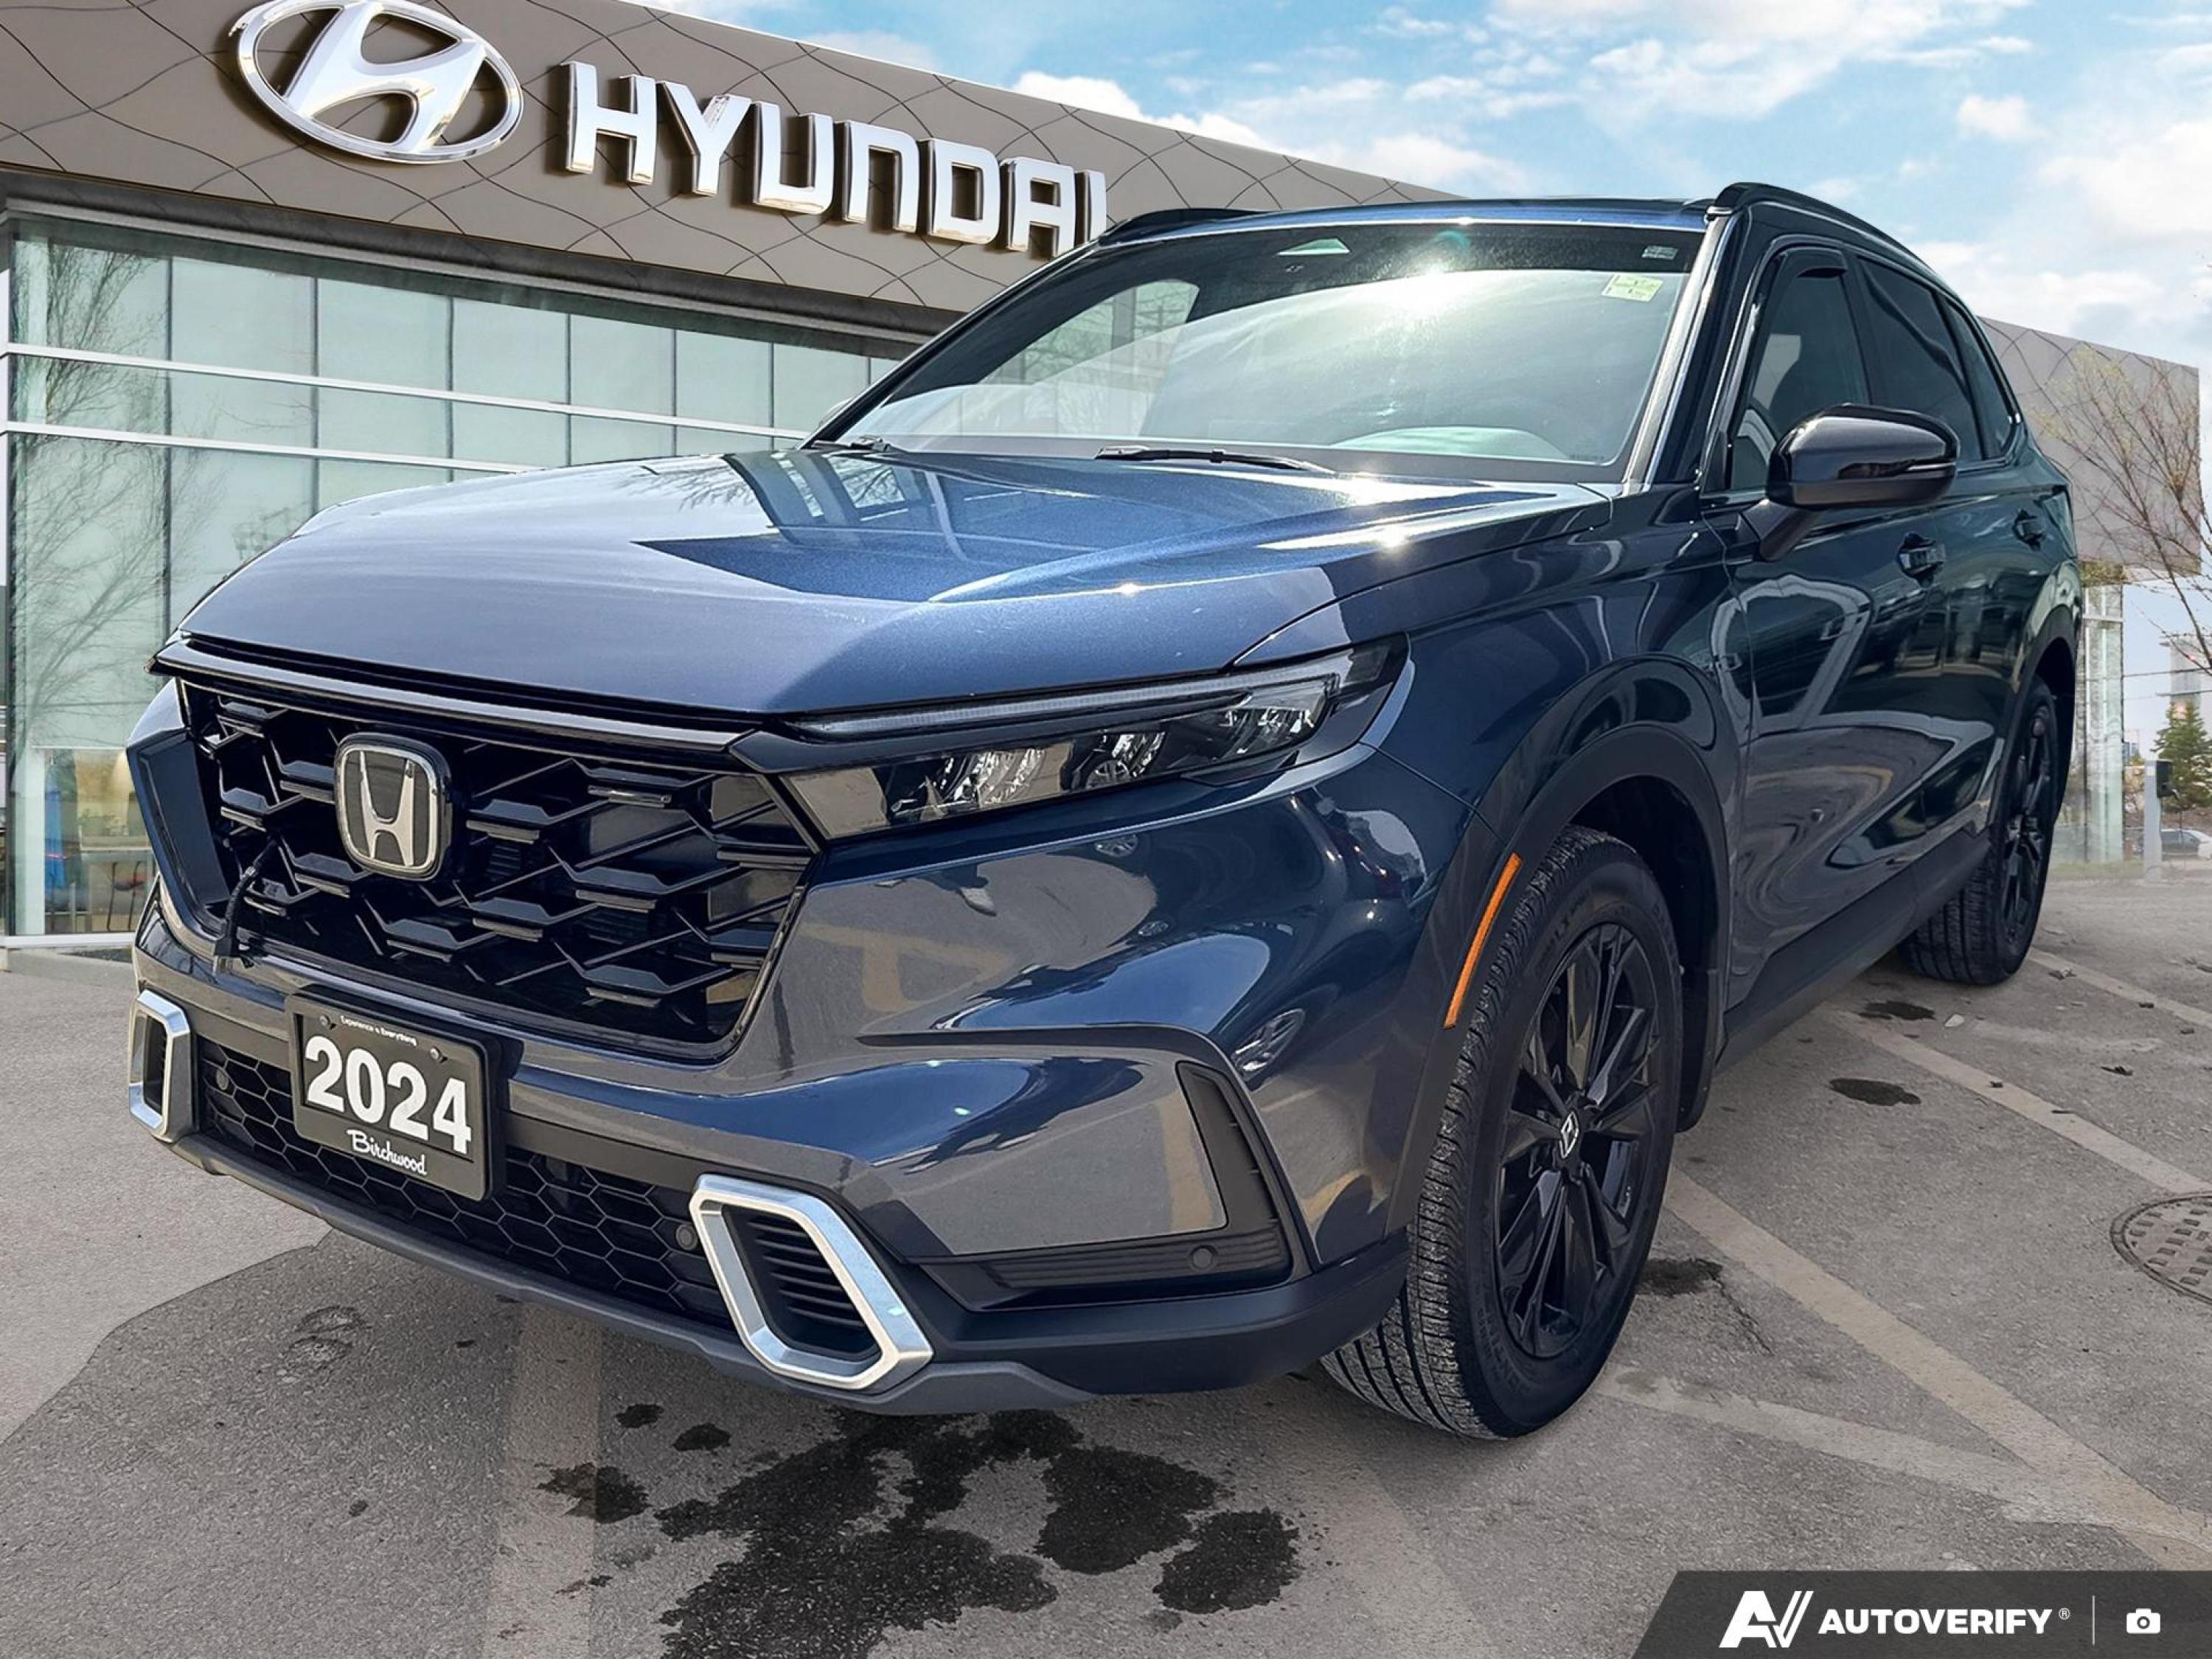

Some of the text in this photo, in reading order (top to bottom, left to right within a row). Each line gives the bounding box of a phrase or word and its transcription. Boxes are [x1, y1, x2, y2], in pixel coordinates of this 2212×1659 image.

[560, 61, 1107, 258] HYUNDAI
[305, 1035, 472, 1155] 2024
[346, 1129, 428, 1175] Birchwood
